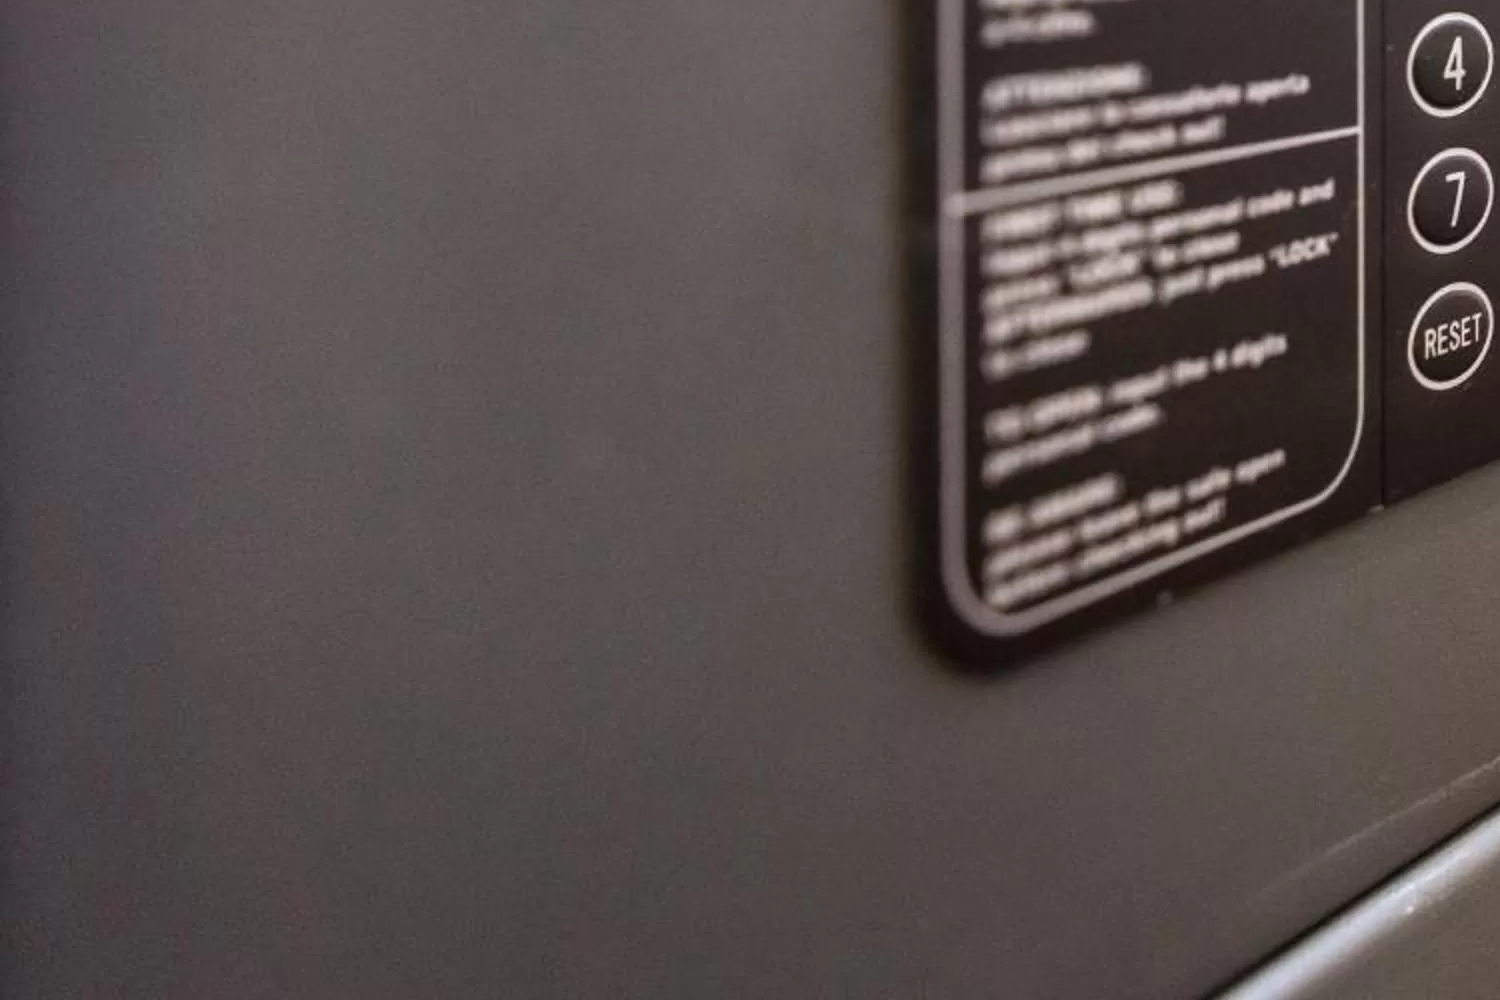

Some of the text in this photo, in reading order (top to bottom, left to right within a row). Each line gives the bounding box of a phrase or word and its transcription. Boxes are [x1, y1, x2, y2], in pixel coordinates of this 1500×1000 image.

[1443, 35, 1467, 91] 4
[1298, 178, 1335, 206] and
[1445, 170, 1466, 228] 7
[1424, 311, 1483, 361] RESET
